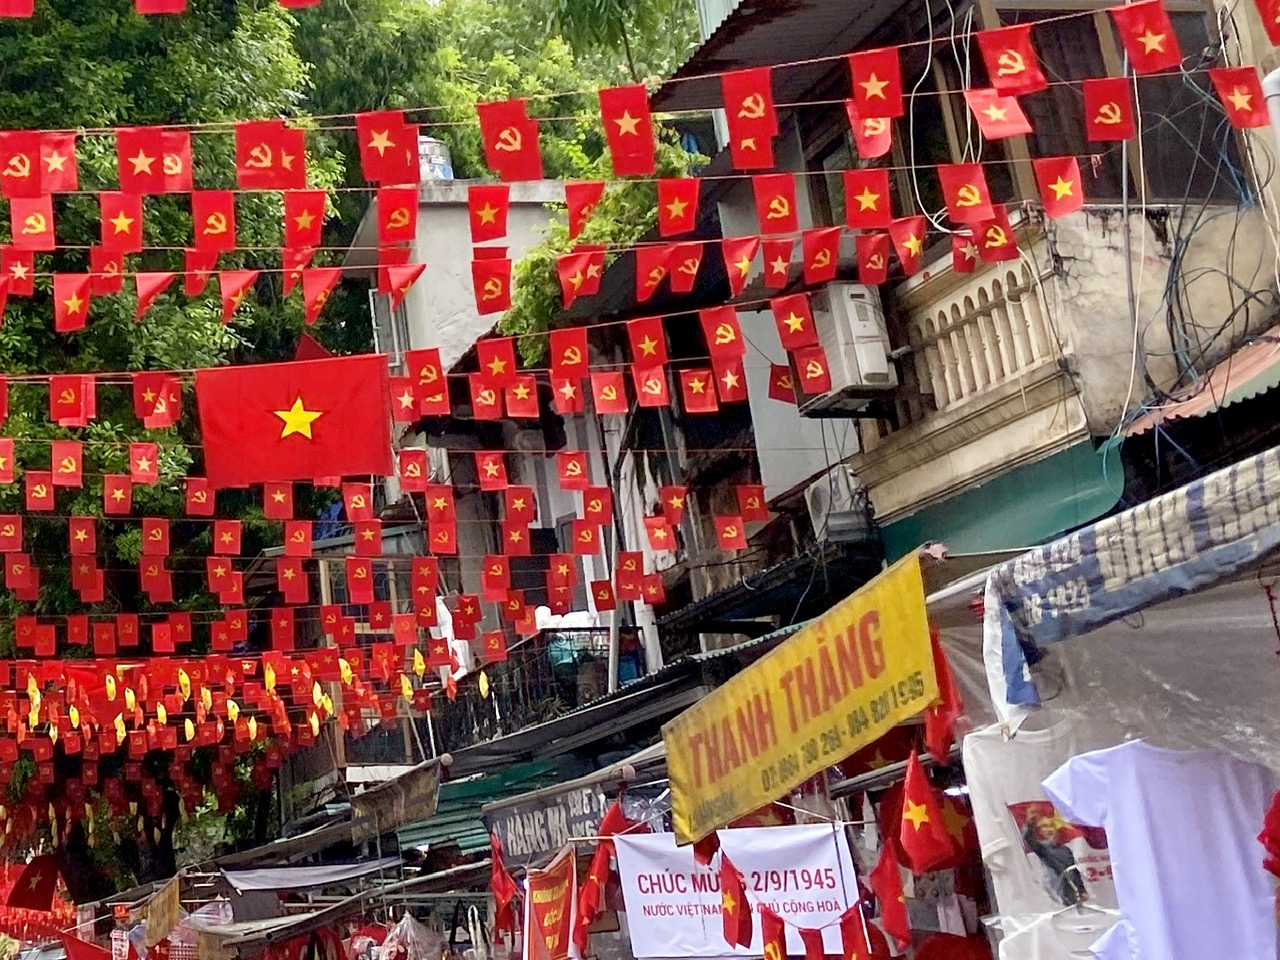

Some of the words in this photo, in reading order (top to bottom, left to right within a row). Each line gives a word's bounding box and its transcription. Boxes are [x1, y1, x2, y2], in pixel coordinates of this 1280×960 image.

[688, 686, 777, 789] THANH
[637, 868, 687, 894] CHÚC
[751, 868, 836, 893] 2/9/1945
[643, 901, 674, 916] NƯỚC
[676, 900, 700, 917] VIỆT
[783, 899, 815, 916] CỘNG
